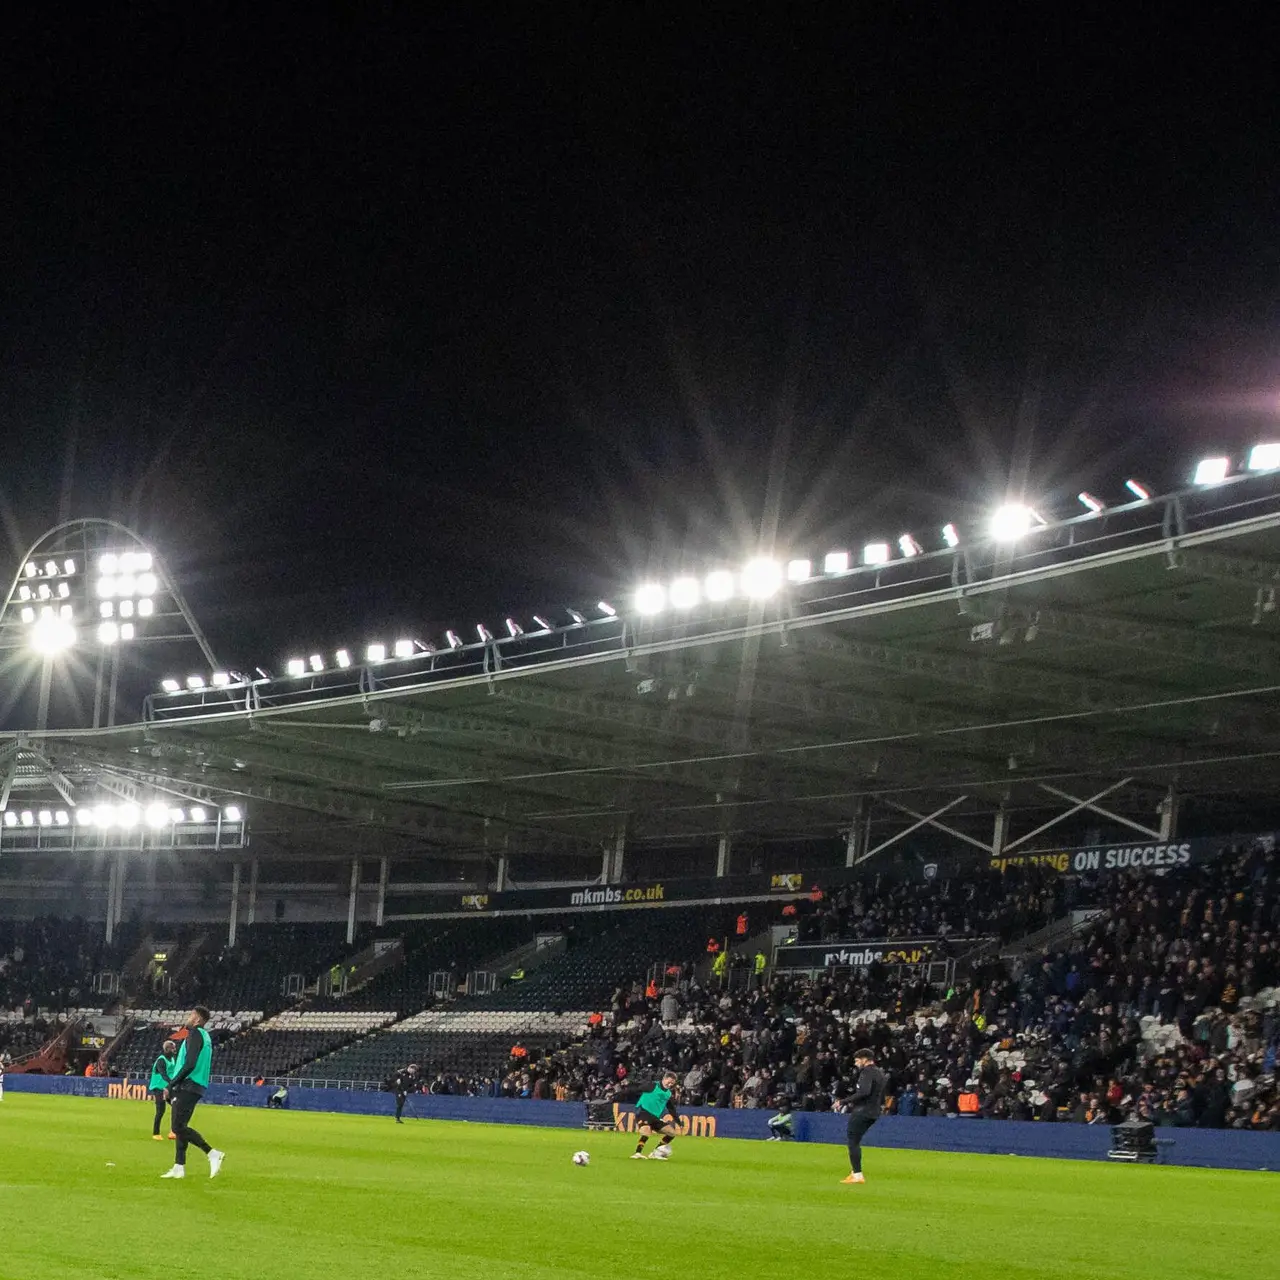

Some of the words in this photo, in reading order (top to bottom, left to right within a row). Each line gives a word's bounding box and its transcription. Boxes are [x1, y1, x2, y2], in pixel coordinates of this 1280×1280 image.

[1074, 851, 1100, 871] ON
[1104, 844, 1191, 869] SUCCESS
[772, 874, 802, 891] MKM
[571, 884, 664, 905] mkmbs.co.uk
